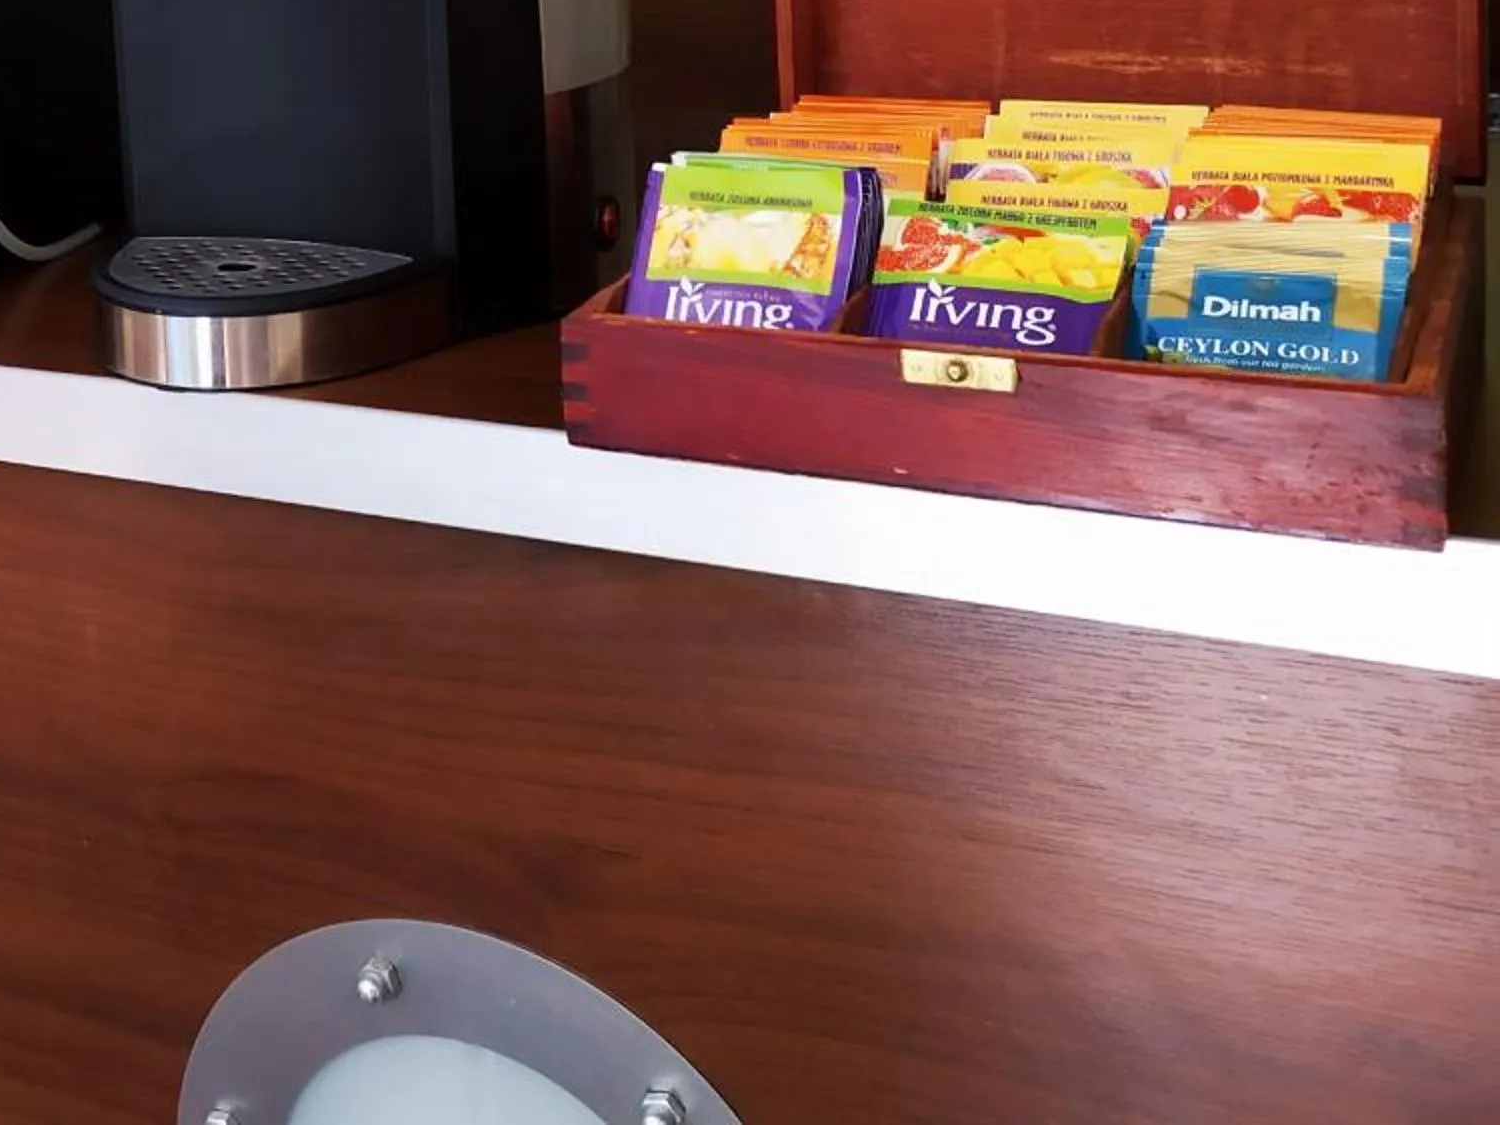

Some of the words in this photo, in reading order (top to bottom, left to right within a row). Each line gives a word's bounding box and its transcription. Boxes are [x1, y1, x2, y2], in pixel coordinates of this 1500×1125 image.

[664, 276, 793, 330] Irving
[909, 278, 1057, 346] Irving
[1201, 294, 1322, 323] Dilmah
[1157, 335, 1270, 357] CEYLON
[1276, 341, 1360, 366] GOLD
